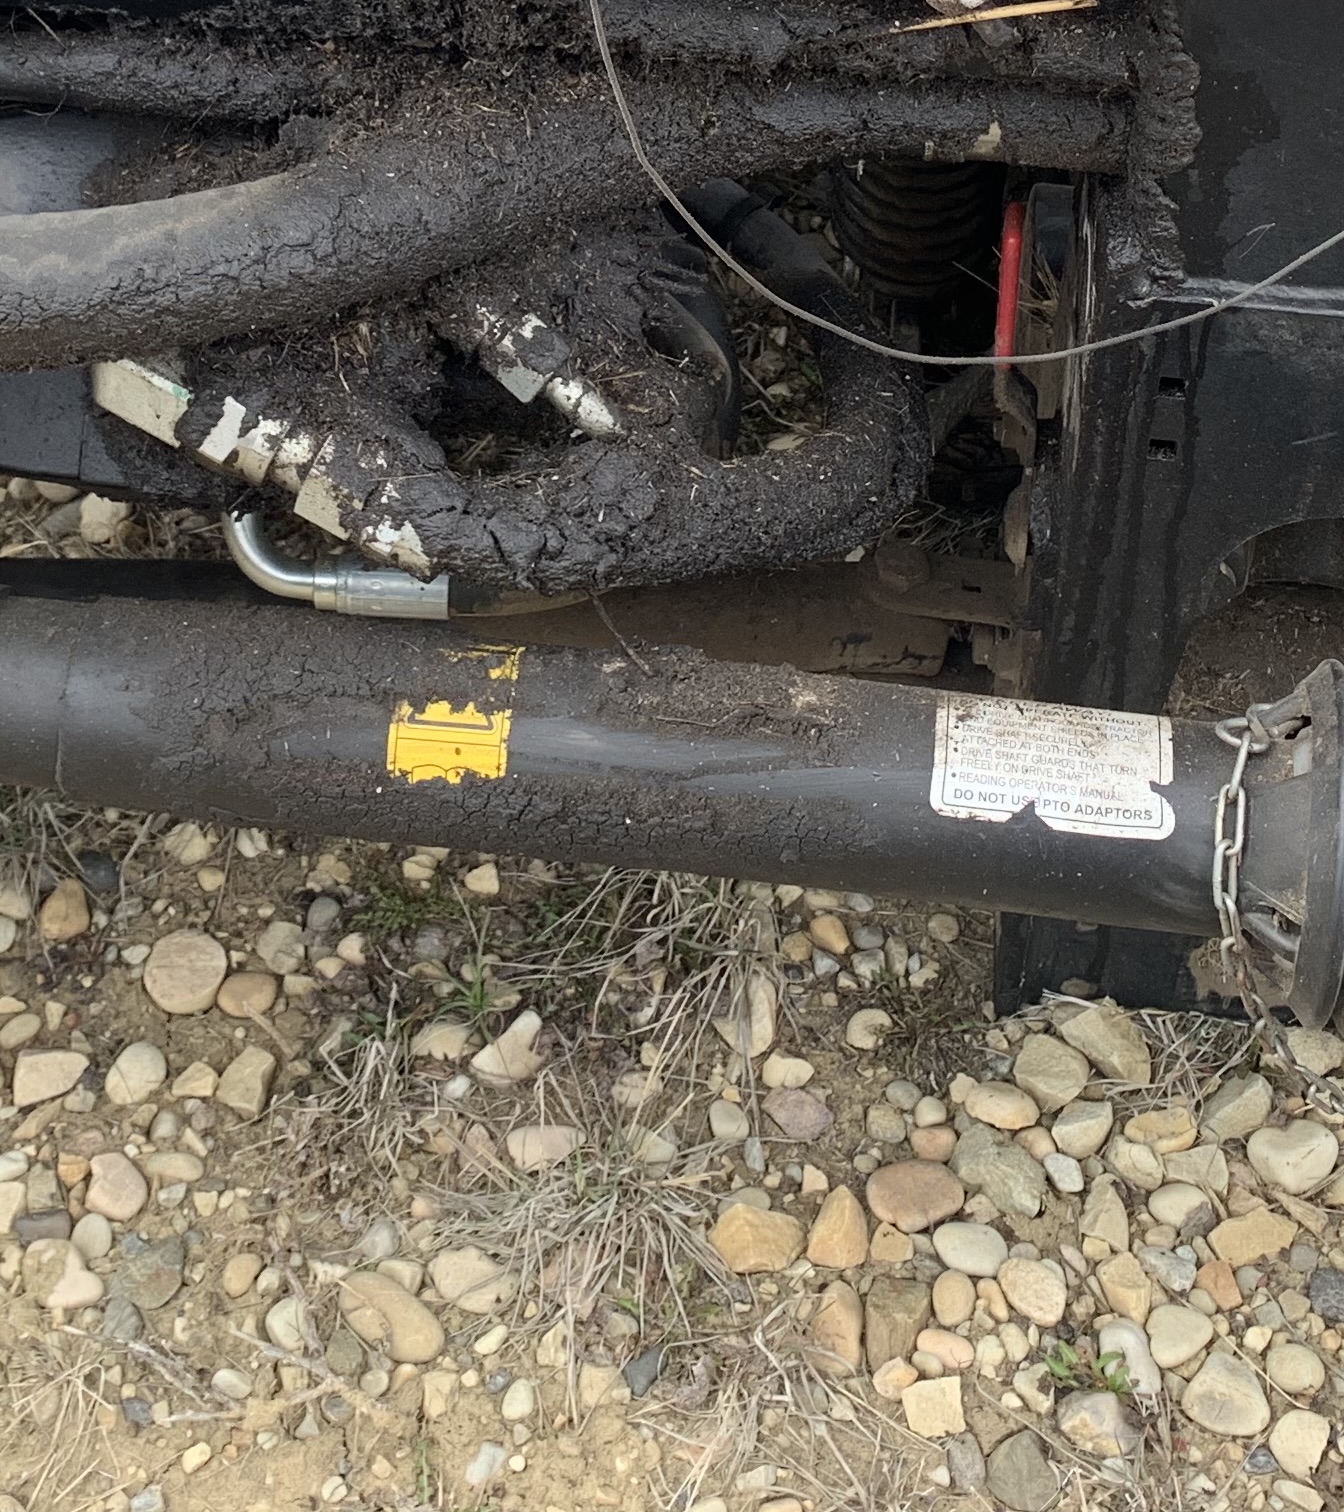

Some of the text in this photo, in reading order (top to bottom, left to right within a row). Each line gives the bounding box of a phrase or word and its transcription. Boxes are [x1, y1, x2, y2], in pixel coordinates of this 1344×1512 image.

[962, 724, 993, 735] DRIVE
[961, 735, 1096, 759] ATTACHED AT BOTH ENDS
[961, 747, 1137, 776] DRIVE SHAFT GUARDS THAT TURN
[961, 758, 1090, 781] FREELY ON DRIVE SHAFT
[959, 772, 1006, 787] READING
[1079, 787, 1124, 801] MANUAL
[954, 789, 973, 800] DO
[978, 791, 1007, 804] NOT
[1043, 799, 1070, 813] PTO
[1075, 804, 1153, 821] ADAPTORS
